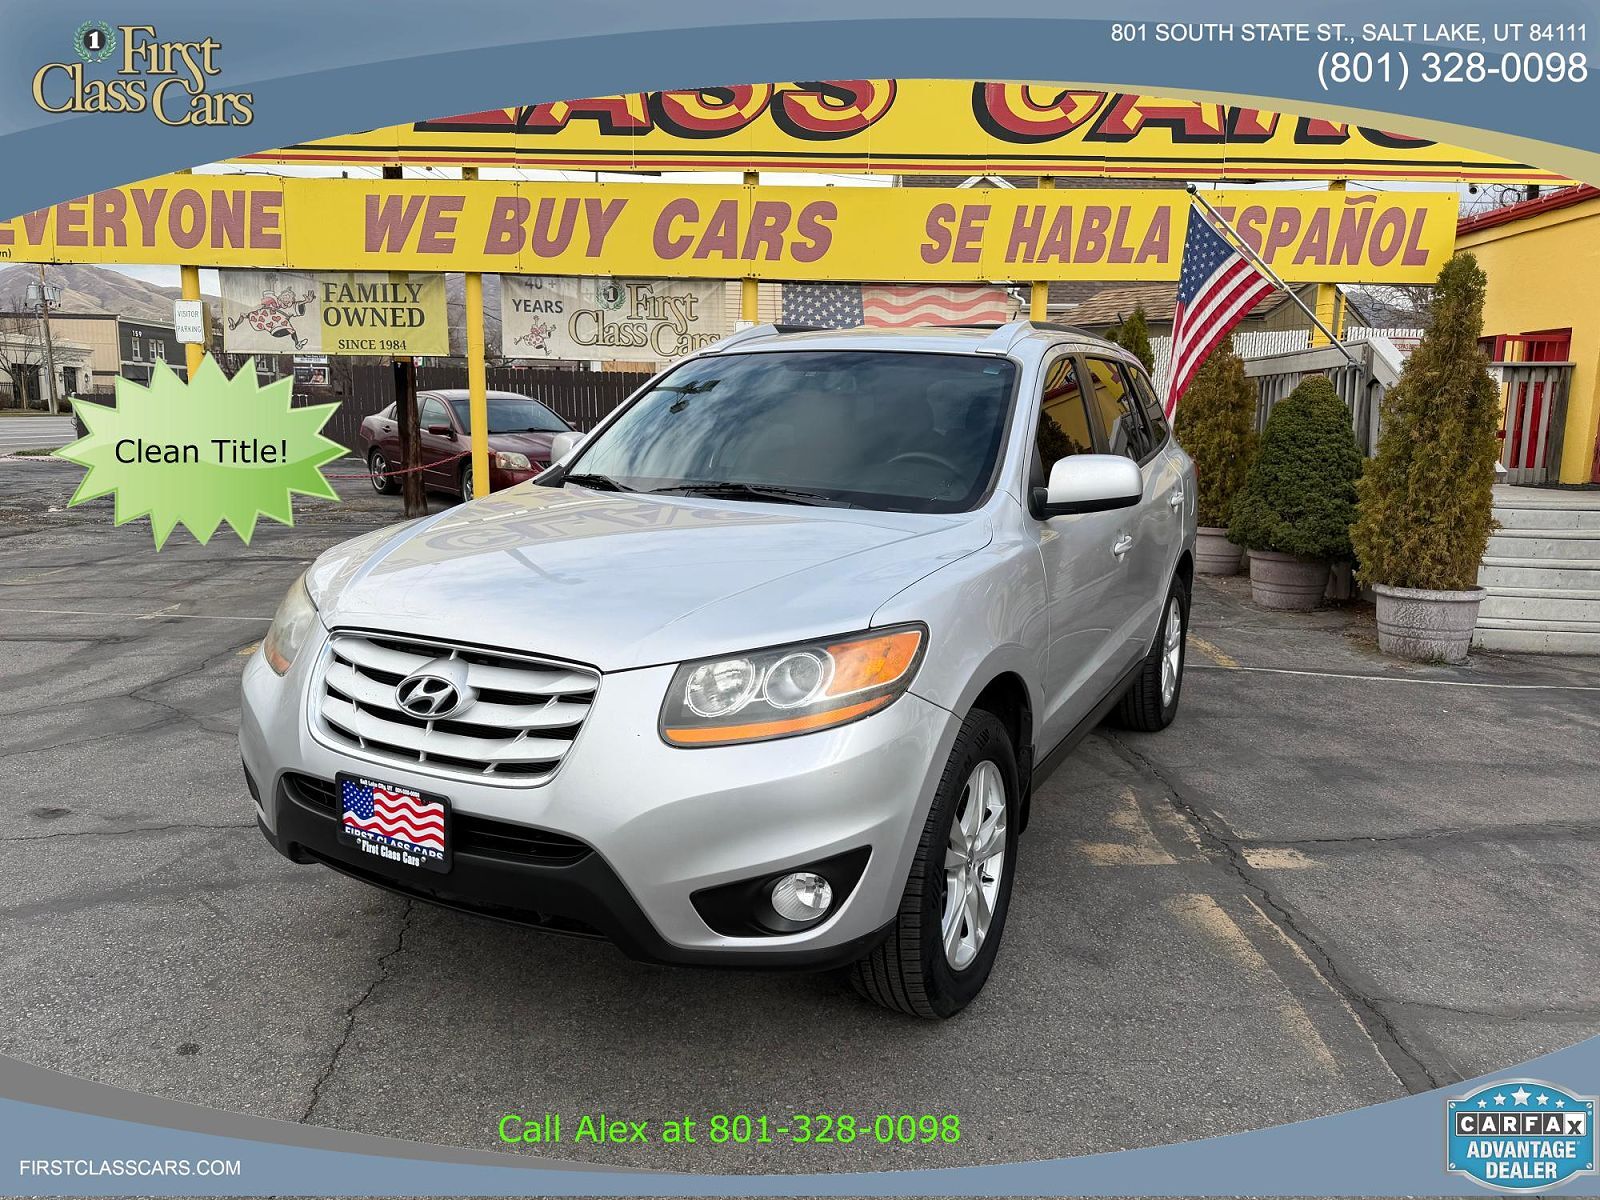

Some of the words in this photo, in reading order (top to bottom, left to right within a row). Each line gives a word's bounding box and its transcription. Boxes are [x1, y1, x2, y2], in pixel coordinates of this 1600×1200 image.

[364, 194, 465, 254] WE
[483, 196, 628, 259] BUY
[652, 198, 838, 263] CARS
[920, 203, 992, 264] SE
[1004, 204, 1171, 264] HABLA
[322, 282, 424, 303] FAMILY
[177, 310, 199, 318] VISITOR
[511, 298, 563, 314] YEARS
[626, 283, 699, 335] First
[323, 307, 425, 328] OWNED
[568, 308, 648, 348] Class
[176, 325, 202, 333] PARKING
[338, 340, 376, 350] SINCE
[379, 340, 407, 351] 1984
[361, 840, 379, 856] First
[380, 844, 401, 862] Class
[402, 851, 421, 867] Cars
